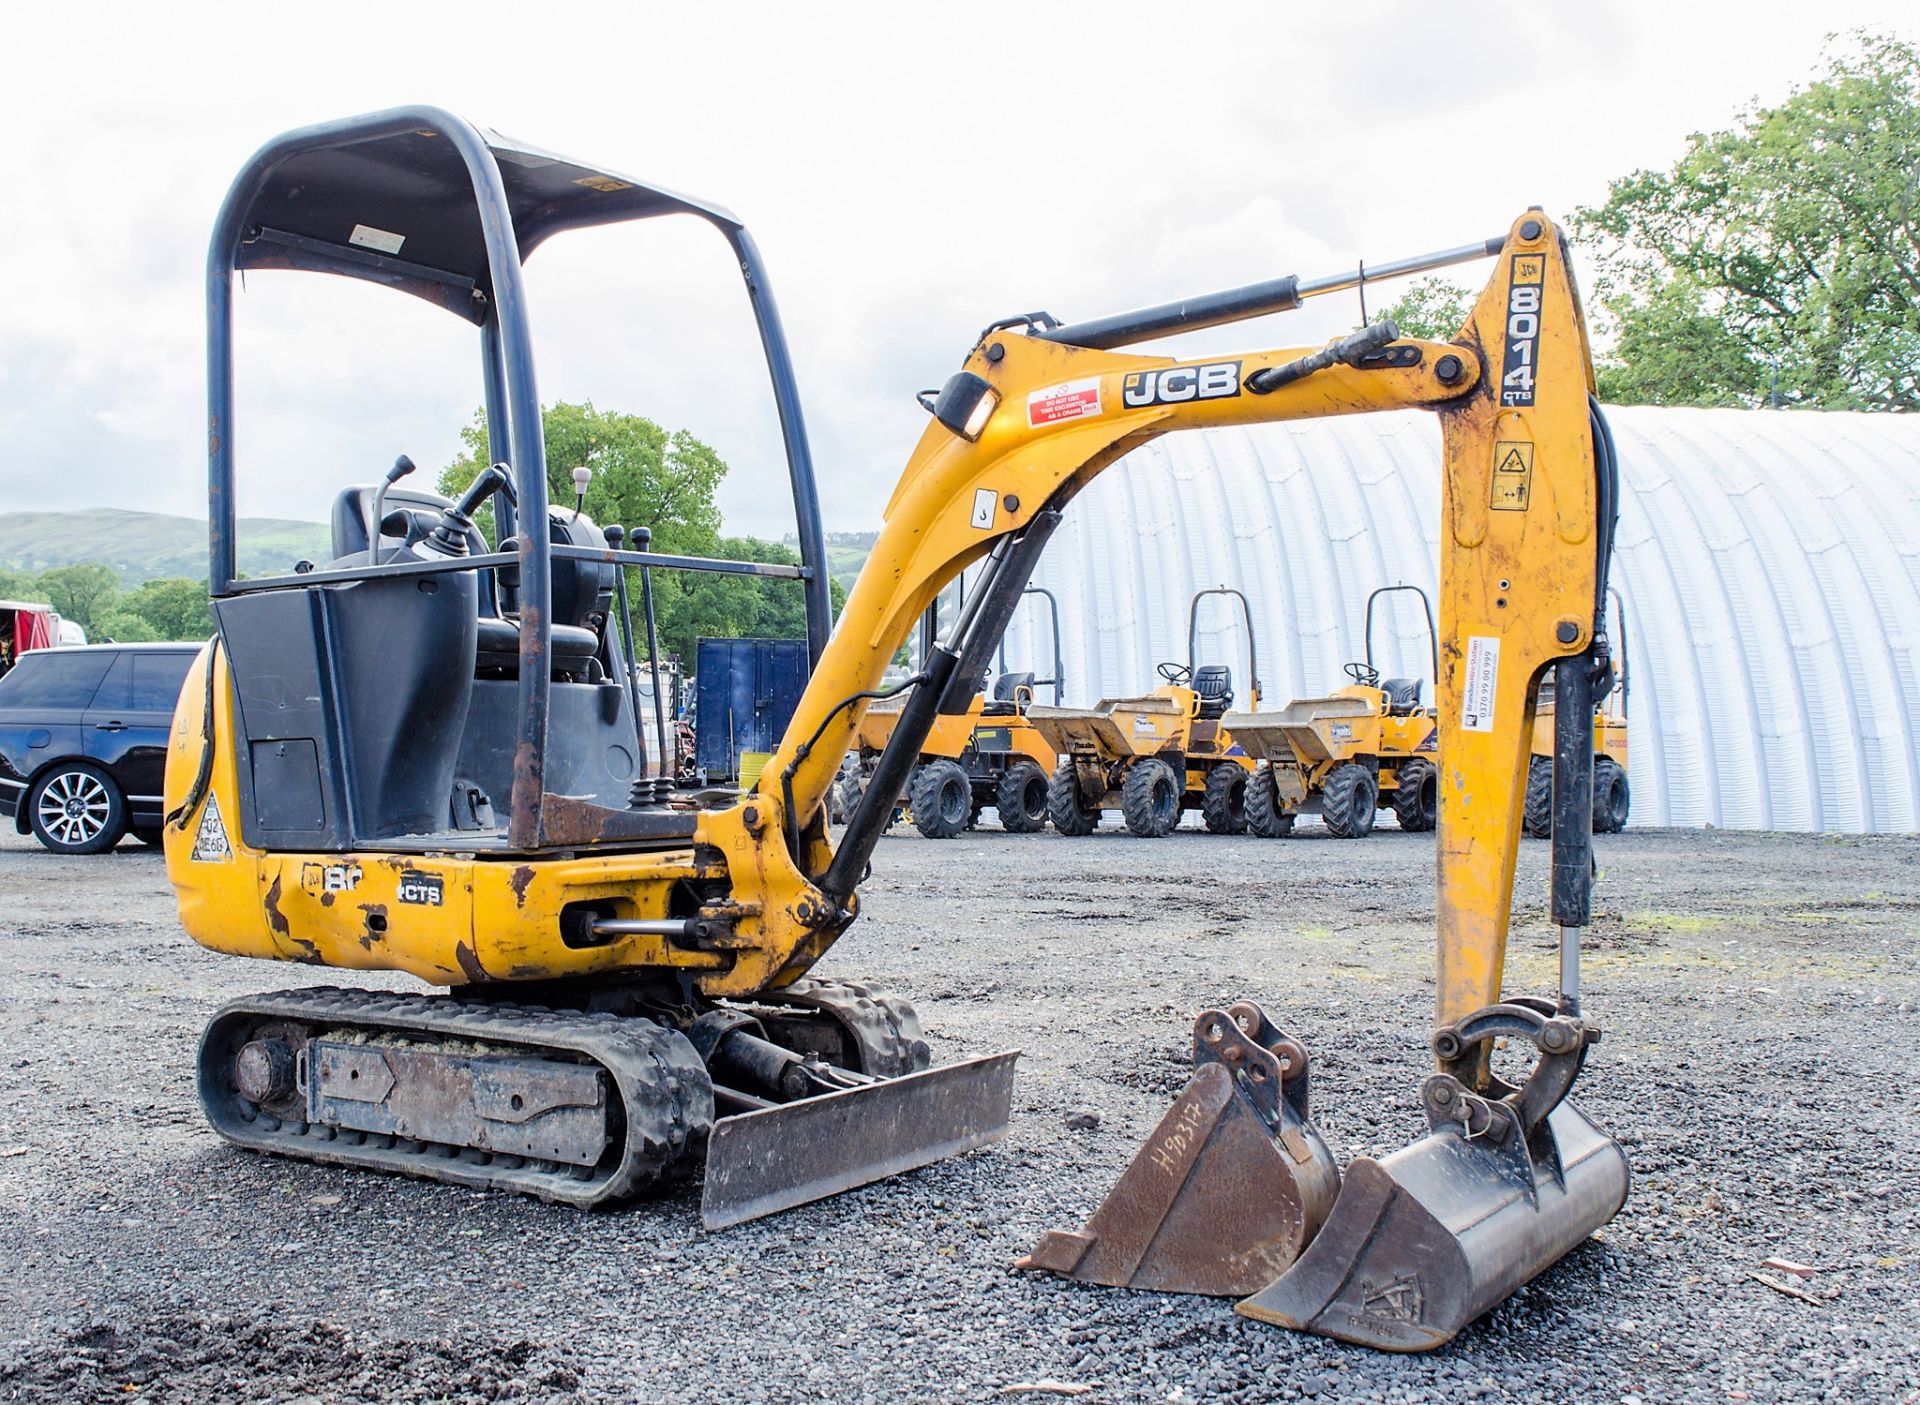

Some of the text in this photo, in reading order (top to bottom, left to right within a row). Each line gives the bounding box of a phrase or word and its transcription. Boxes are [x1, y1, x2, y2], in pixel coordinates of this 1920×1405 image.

[1503, 287, 1540, 391] 8014
[1125, 363, 1239, 406] JCB
[1503, 391, 1532, 400] CTS
[1483, 650, 1493, 668] 999
[1482, 669, 1491, 681] 00
[1481, 682, 1489, 695] 99
[1479, 695, 1489, 718] 0370
